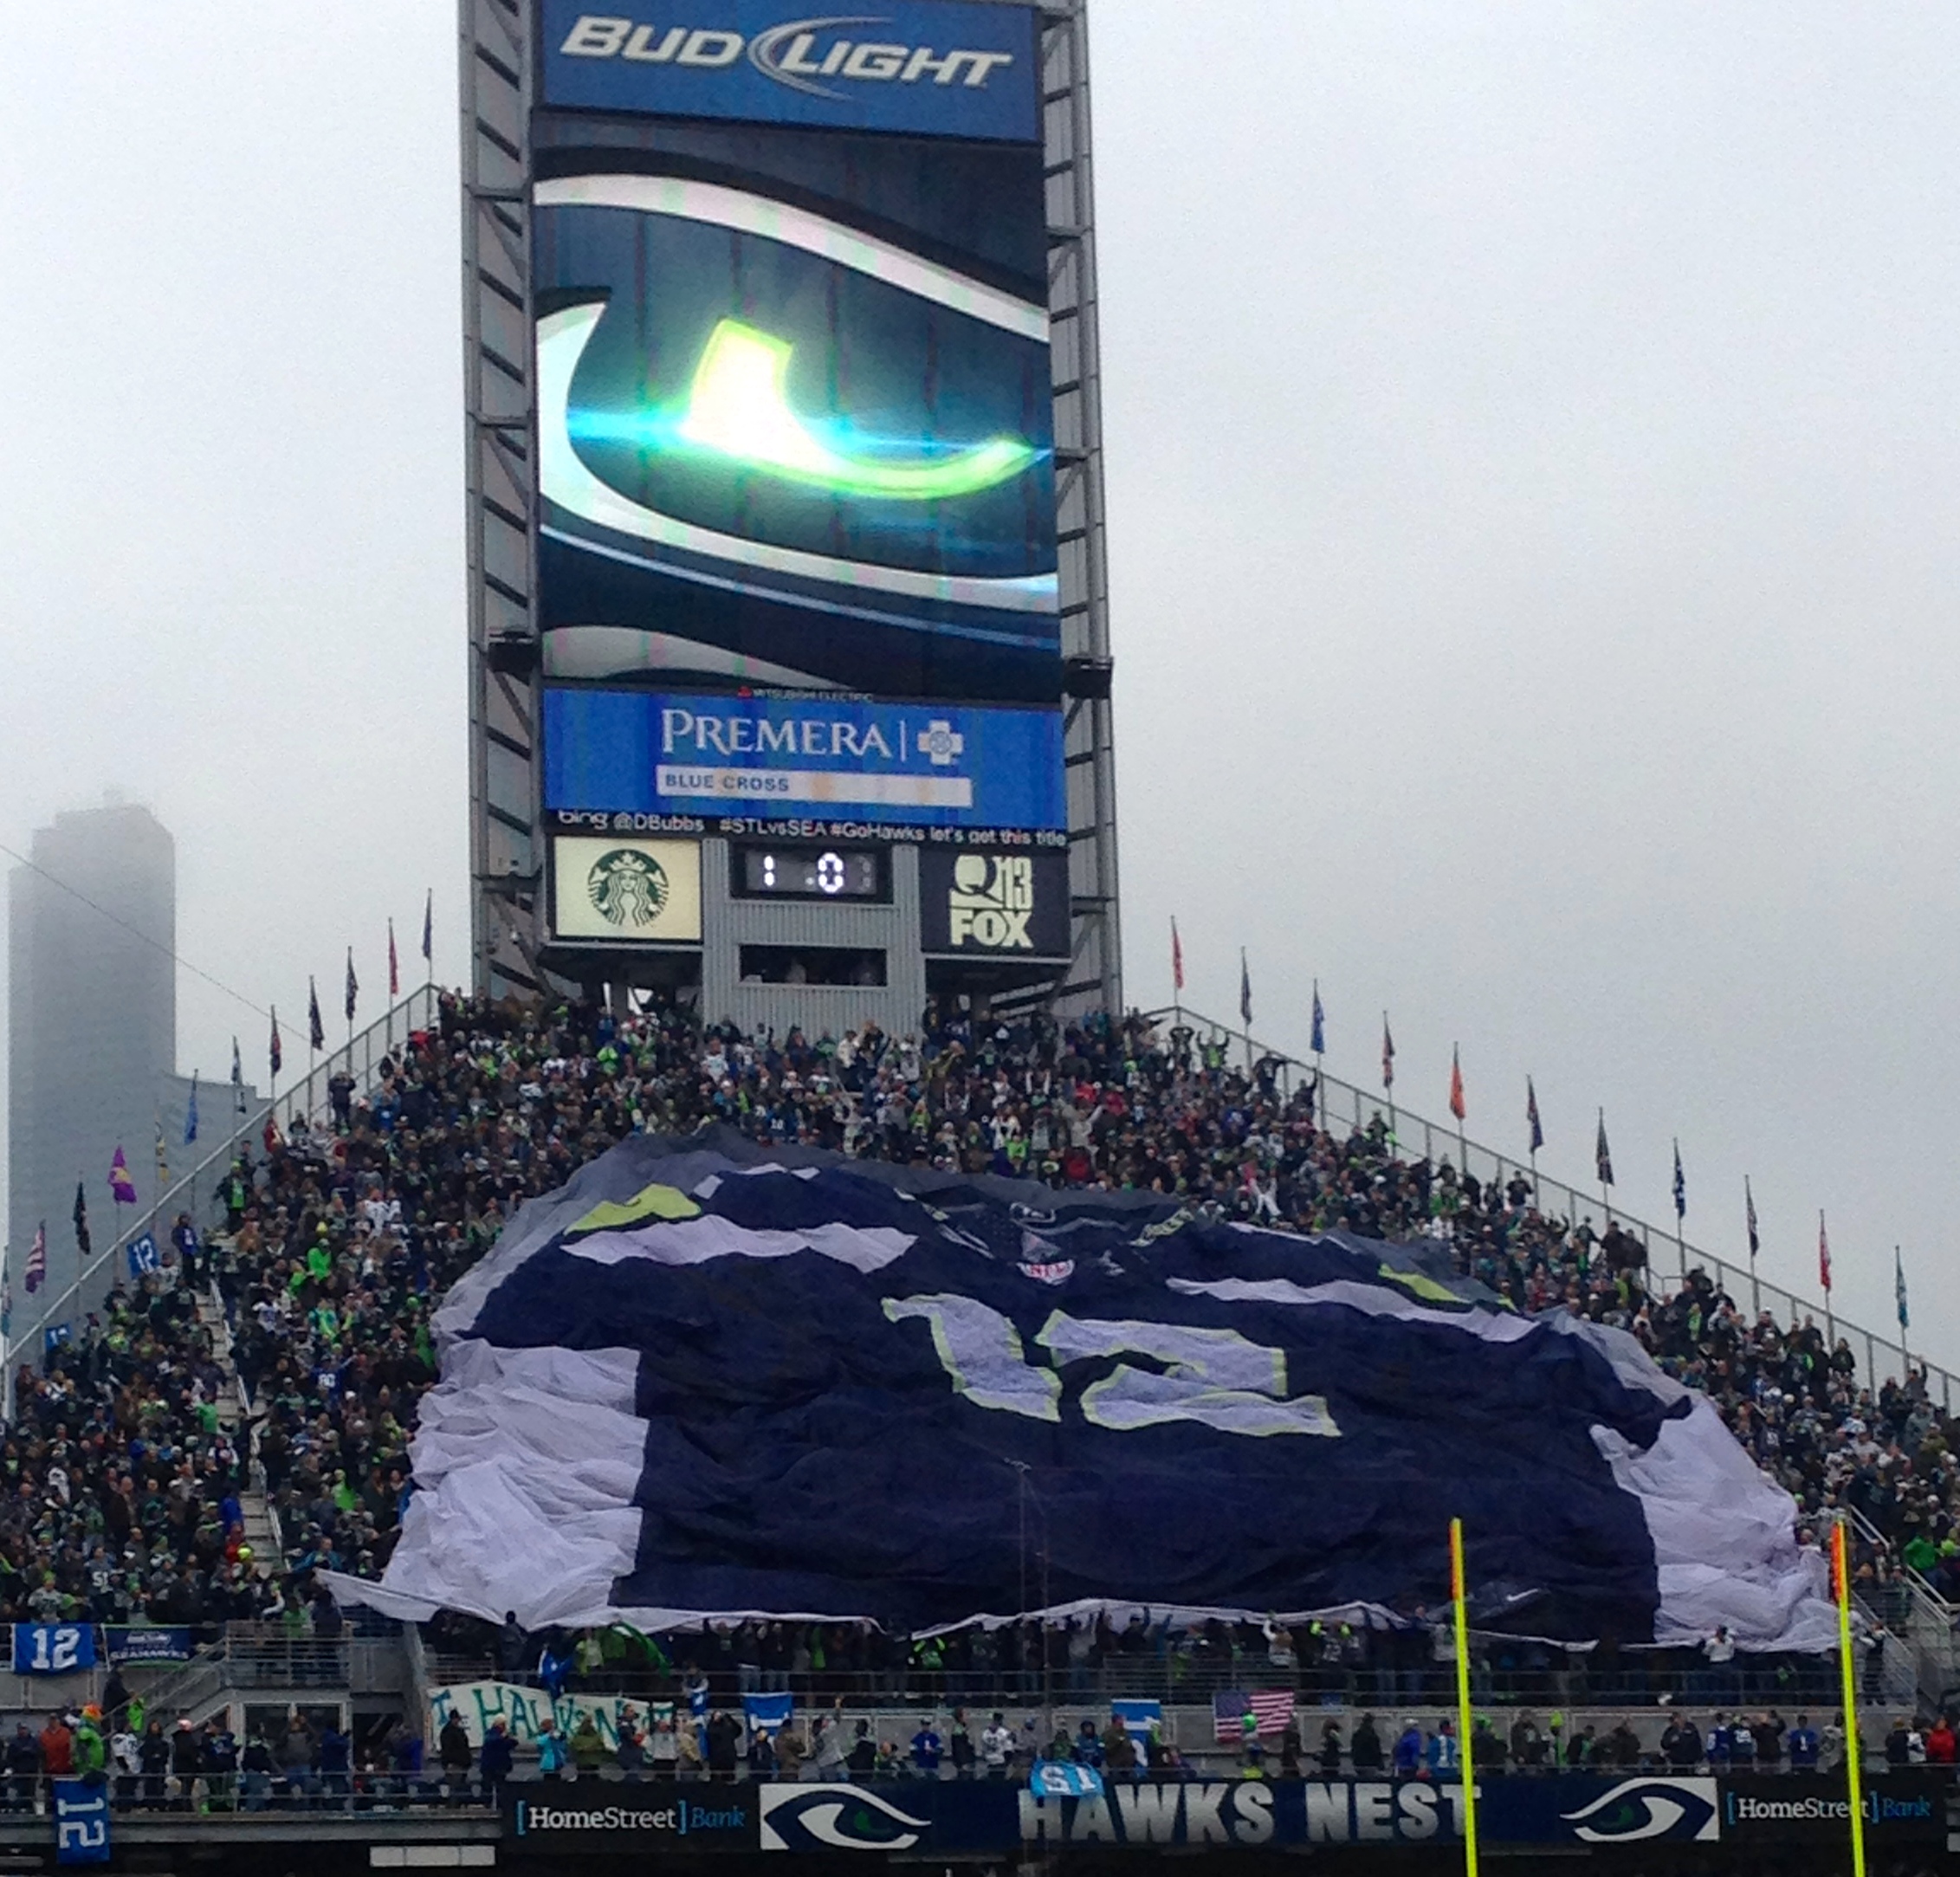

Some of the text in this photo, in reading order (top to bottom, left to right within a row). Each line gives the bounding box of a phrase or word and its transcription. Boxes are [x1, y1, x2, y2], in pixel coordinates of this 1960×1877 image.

[560, 16, 1012, 87] BUD LIGHT
[661, 709, 892, 759] PREMERA
[664, 774, 789, 792] BLUE CROSS
[720, 818, 827, 837] #STLvsSEA
[830, 822, 925, 841] #GoHawks
[930, 826, 964, 843] let's
[999, 829, 1032, 845] this
[1036, 831, 1066, 846] title
[954, 854, 1033, 909] Q13
[950, 909, 1034, 948] FOX
[882, 1293, 1342, 1437] 12
[31, 1628, 81, 1670] 12
[57, 1796, 105, 1848] 12
[691, 1805, 745, 1828] Bank
[1018, 1782, 1481, 1843] HAWKS NEST
[1883, 1796, 1931, 1817] Bank
